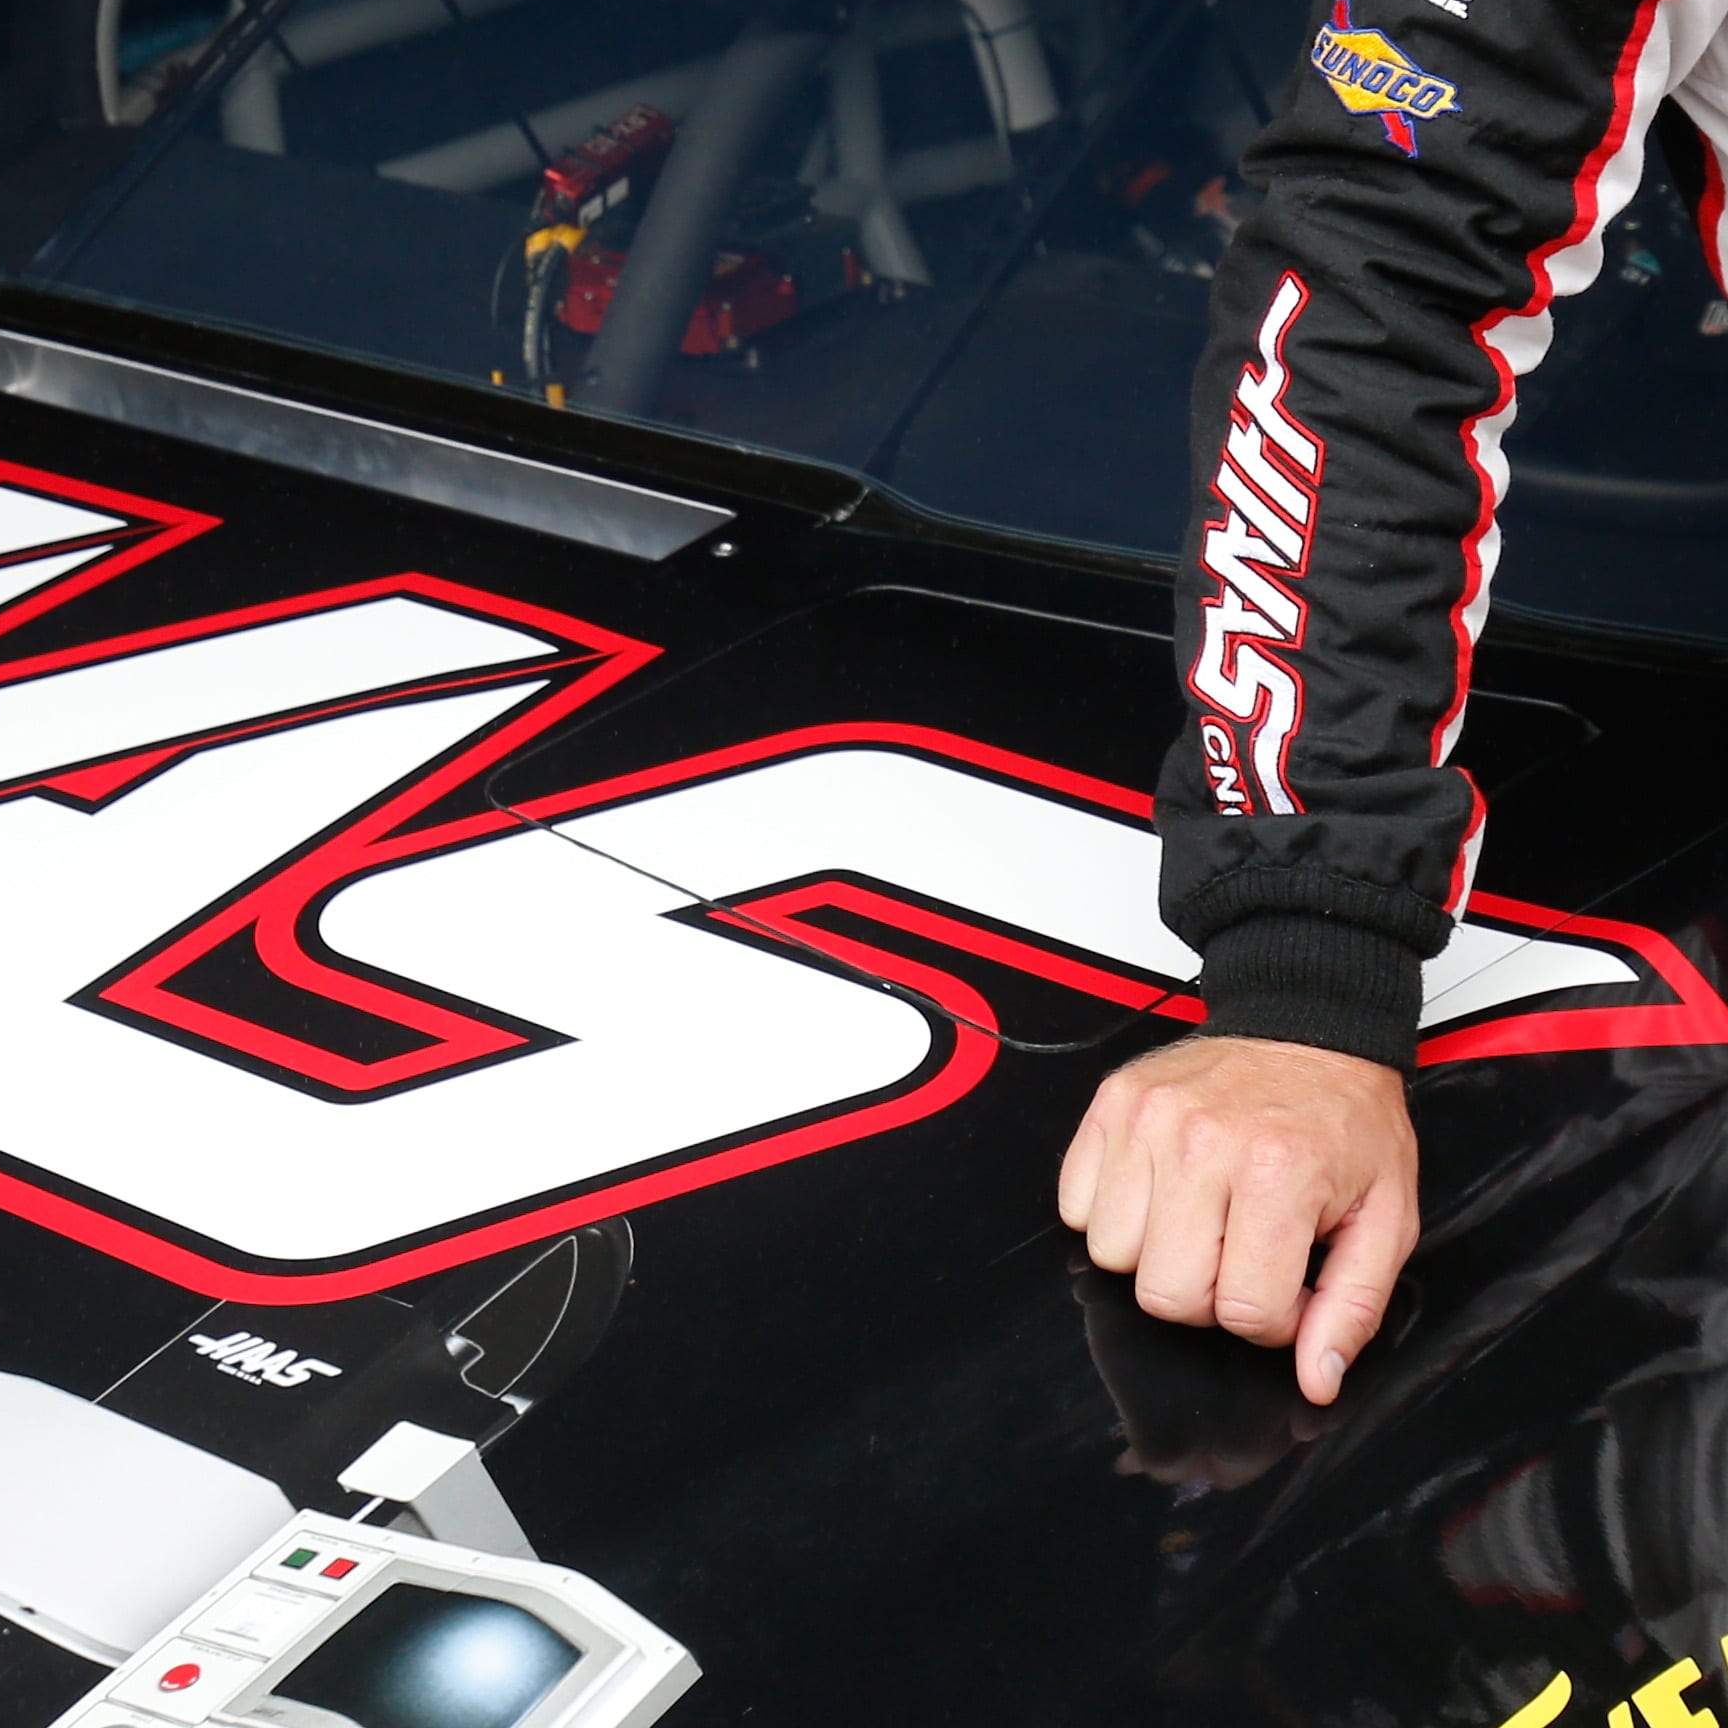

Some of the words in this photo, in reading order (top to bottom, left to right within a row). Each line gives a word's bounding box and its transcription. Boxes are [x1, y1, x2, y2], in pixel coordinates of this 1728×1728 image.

[1313, 31, 1446, 112] SUNOCO
[1187, 270, 1326, 815] HAAS
[188, 1331, 343, 1387] HAAS
